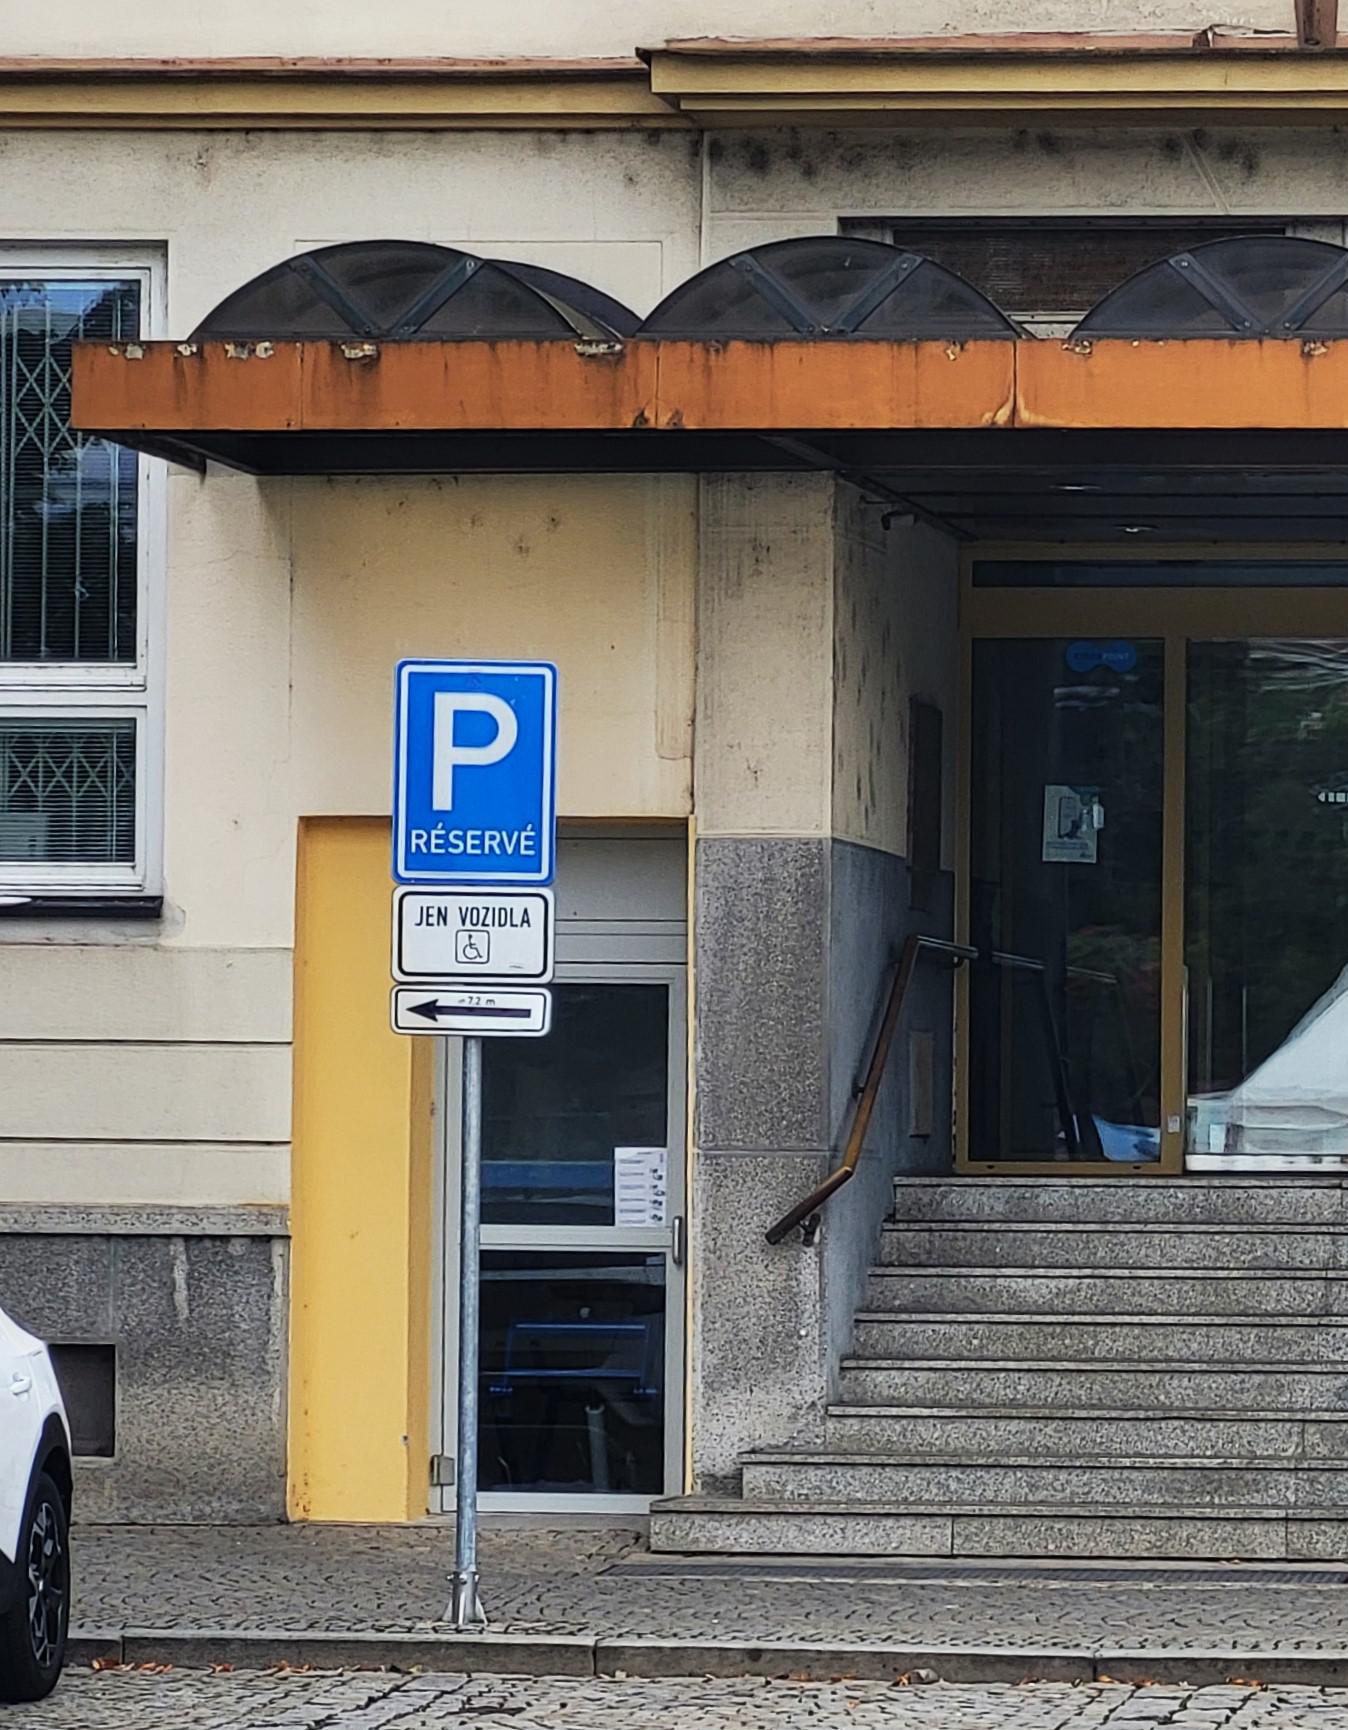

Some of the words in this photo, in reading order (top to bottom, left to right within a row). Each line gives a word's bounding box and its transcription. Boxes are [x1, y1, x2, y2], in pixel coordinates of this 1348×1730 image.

[432, 691, 518, 812] P
[411, 824, 537, 856] RÉSERVÉ
[415, 906, 448, 927] JEN
[458, 907, 532, 928] VOZIDLA
